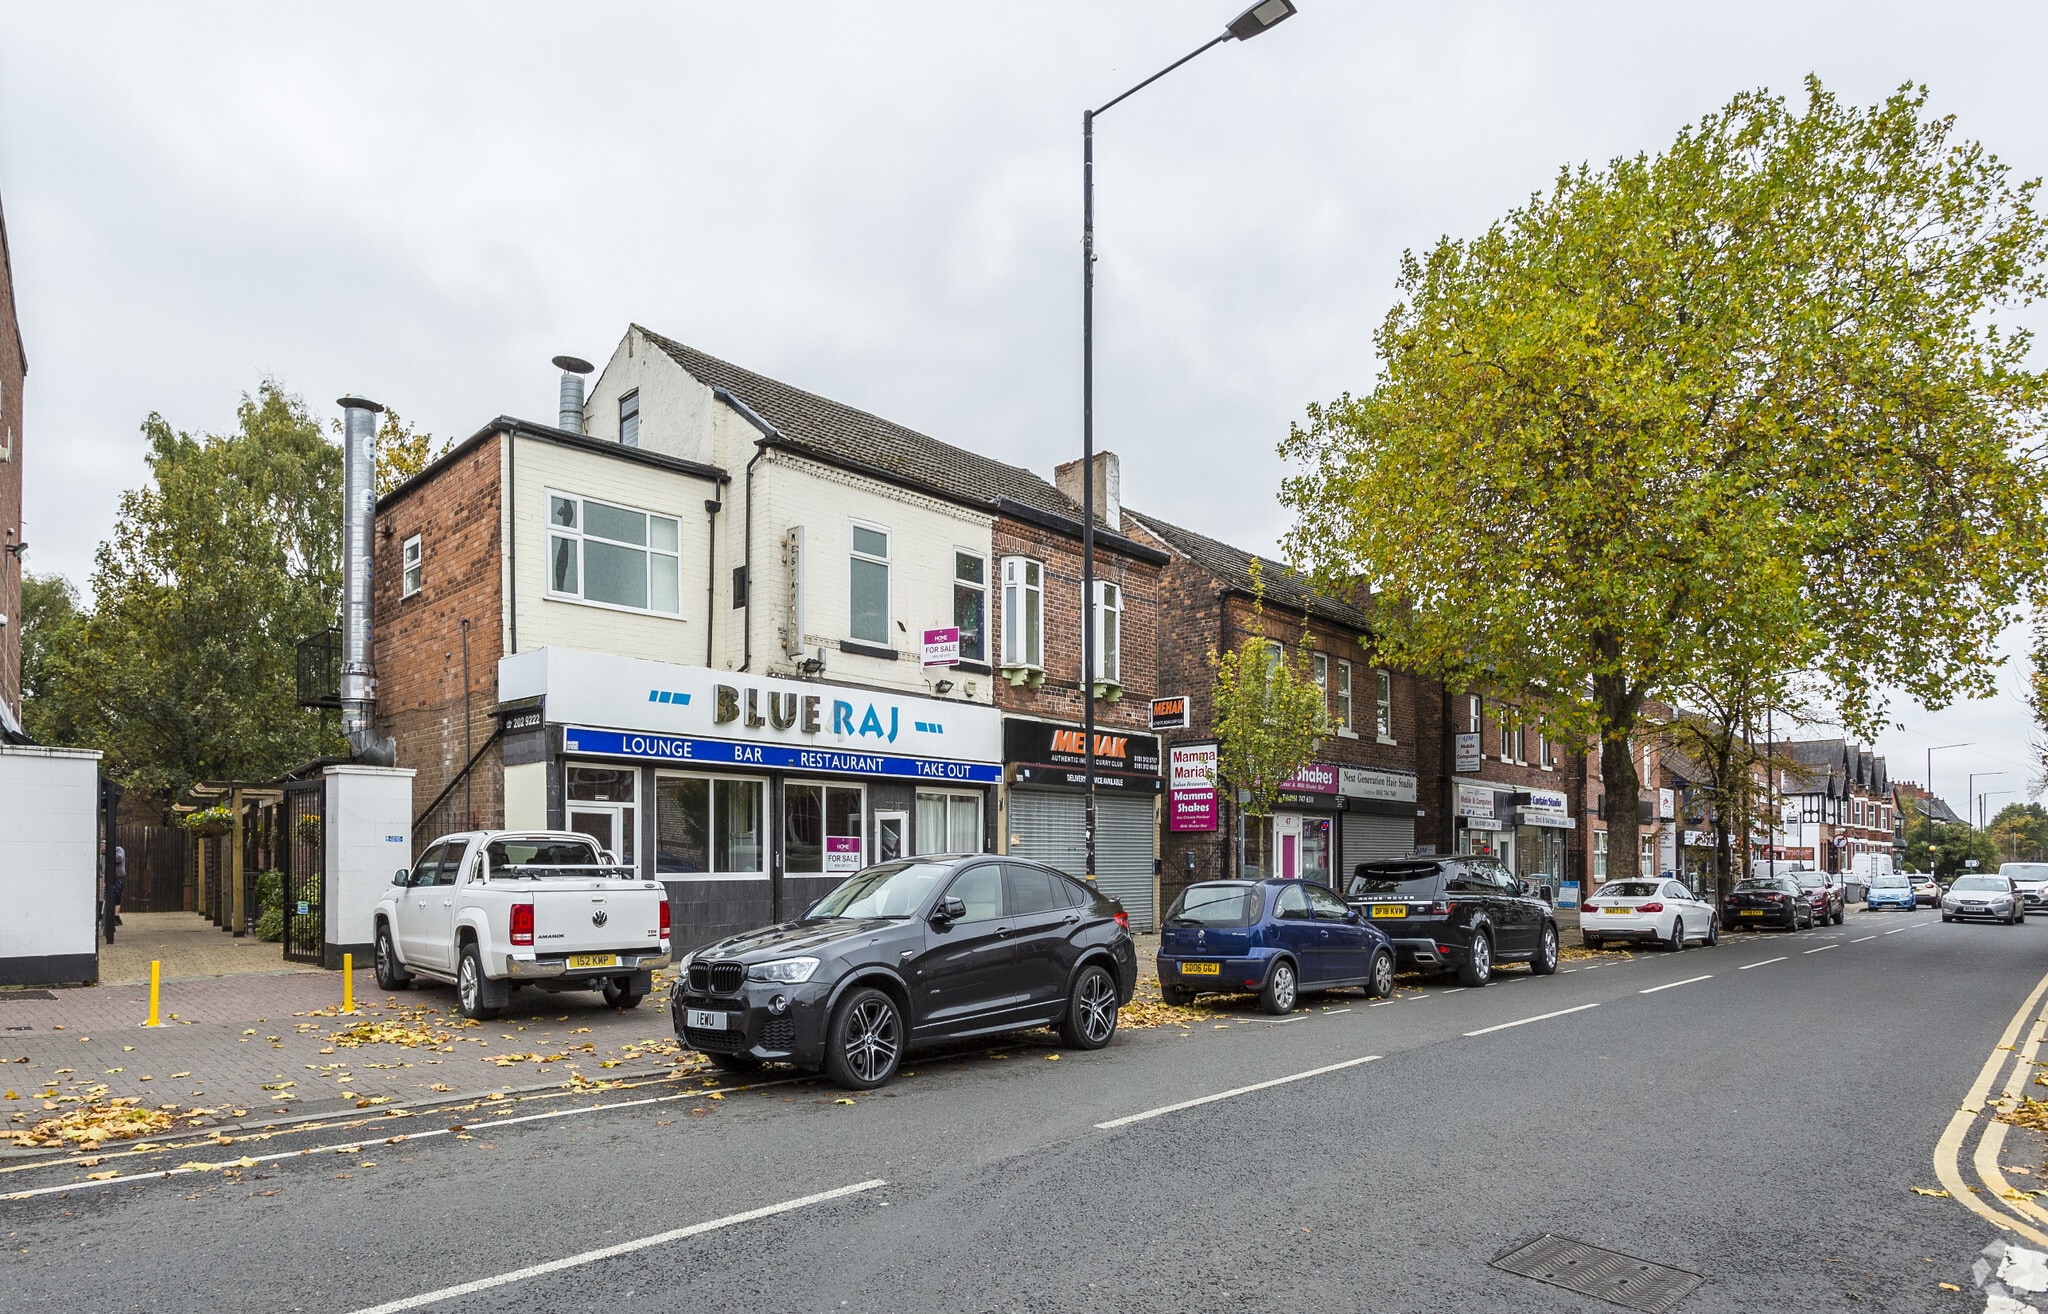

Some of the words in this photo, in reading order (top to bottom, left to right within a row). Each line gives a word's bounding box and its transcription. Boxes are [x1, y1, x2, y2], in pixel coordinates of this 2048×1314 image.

[925, 646, 939, 654] FOR
[940, 644, 957, 652] SALE
[713, 684, 821, 733] BLUE
[833, 699, 899, 744] RAJ
[1153, 700, 1184, 716] MEHAK
[622, 736, 692, 757] LOUNGE
[734, 745, 763, 762] BAR
[800, 752, 884, 772] RESTAURANT
[916, 761, 944, 776] TAKE
[947, 764, 971, 778] OUT
[1051, 754, 1079, 763] AUTHENTIC
[1173, 751, 1216, 763] Mamma
[1174, 765, 1213, 778] Maria's
[1296, 765, 1333, 785] Shakes
[1343, 770, 1356, 783] Next
[1357, 772, 1385, 786] Generation
[1386, 776, 1398, 788] Hair
[1398, 777, 1414, 789] Studio
[1174, 791, 1213, 801] Mamma
[1178, 802, 1210, 813] Shakes
[576, 955, 590, 966] 152
[592, 955, 609, 965] KMP
